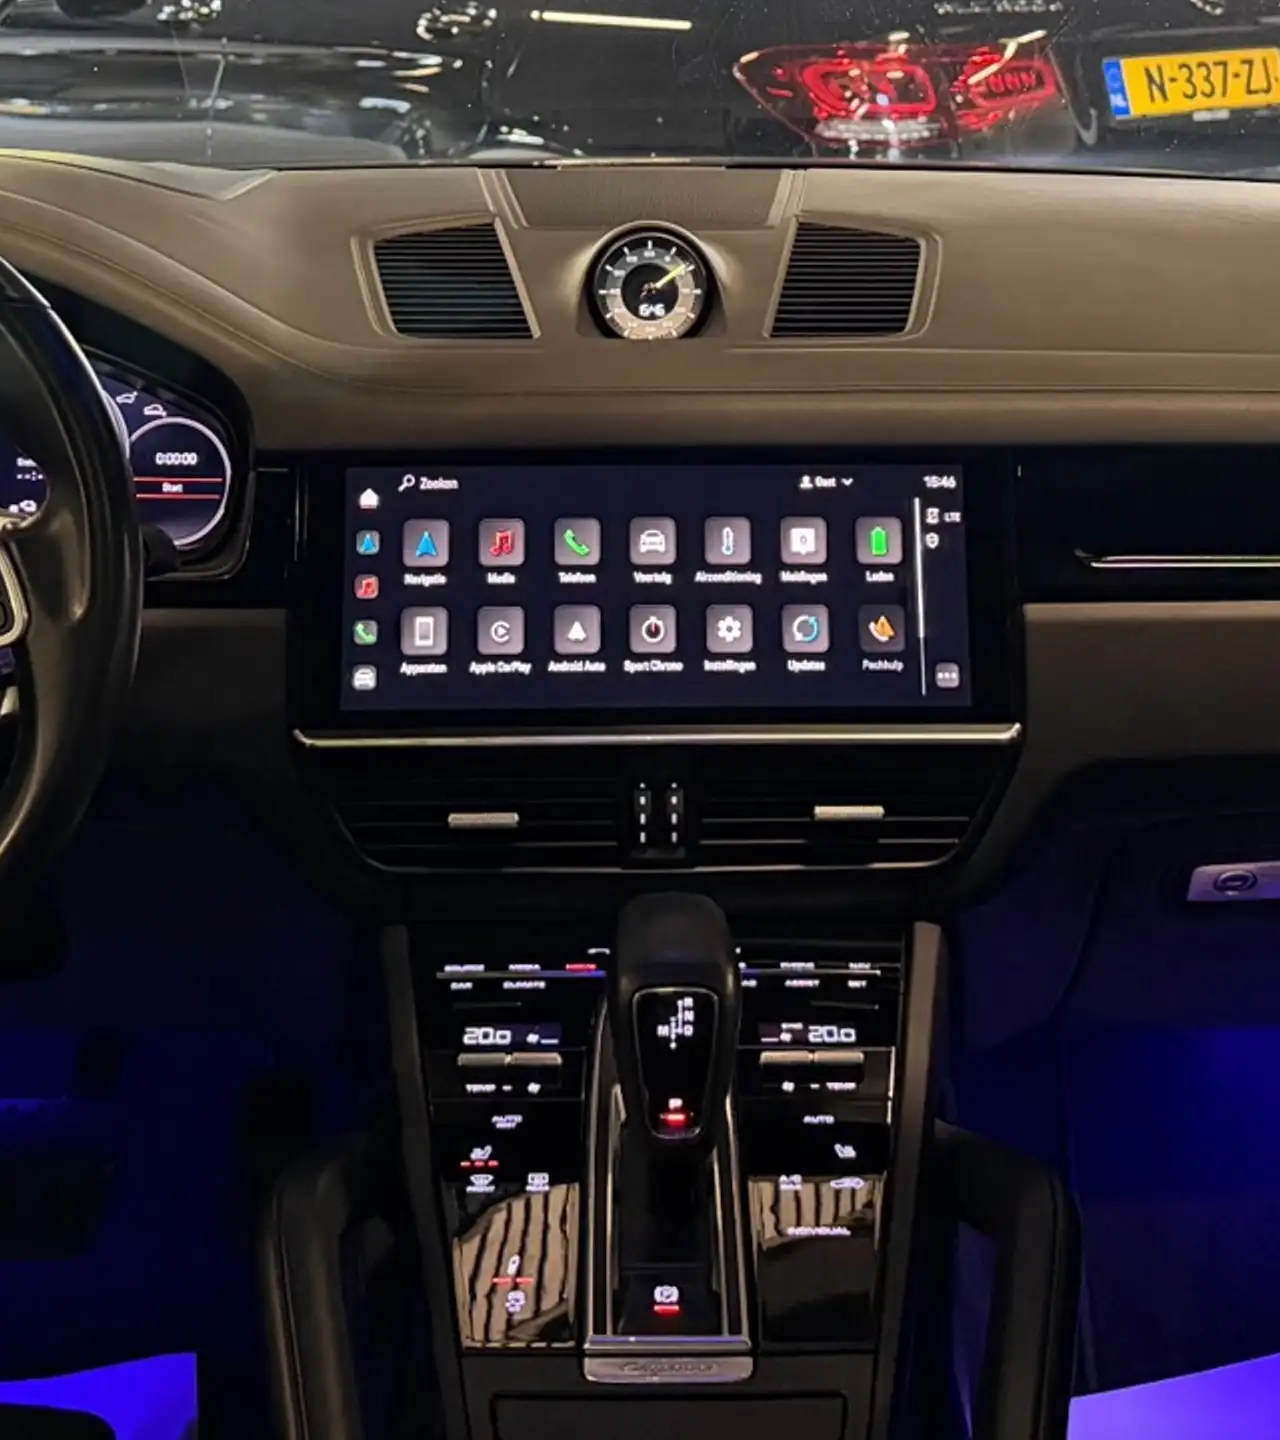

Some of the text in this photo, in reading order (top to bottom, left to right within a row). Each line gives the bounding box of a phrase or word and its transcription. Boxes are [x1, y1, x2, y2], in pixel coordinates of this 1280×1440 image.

[1144, 57, 1273, 103] N-337-ZJ
[420, 476, 459, 490] Zoeken
[404, 573, 448, 587] Navigatie
[487, 572, 516, 584] Media
[557, 572, 596, 584] Telefoon
[633, 572, 673, 585] Voertuig
[779, 571, 828, 584] Meldingen
[865, 571, 895, 583] Laden
[400, 662, 448, 675] Apparaten
[469, 661, 532, 675] Apple CarPlay
[547, 660, 607, 672] Android Auto
[623, 660, 684, 673] Sport Chrono
[703, 659, 757, 673] Instellingen
[787, 659, 826, 673] Updates
[862, 659, 904, 672] Pechhulp
